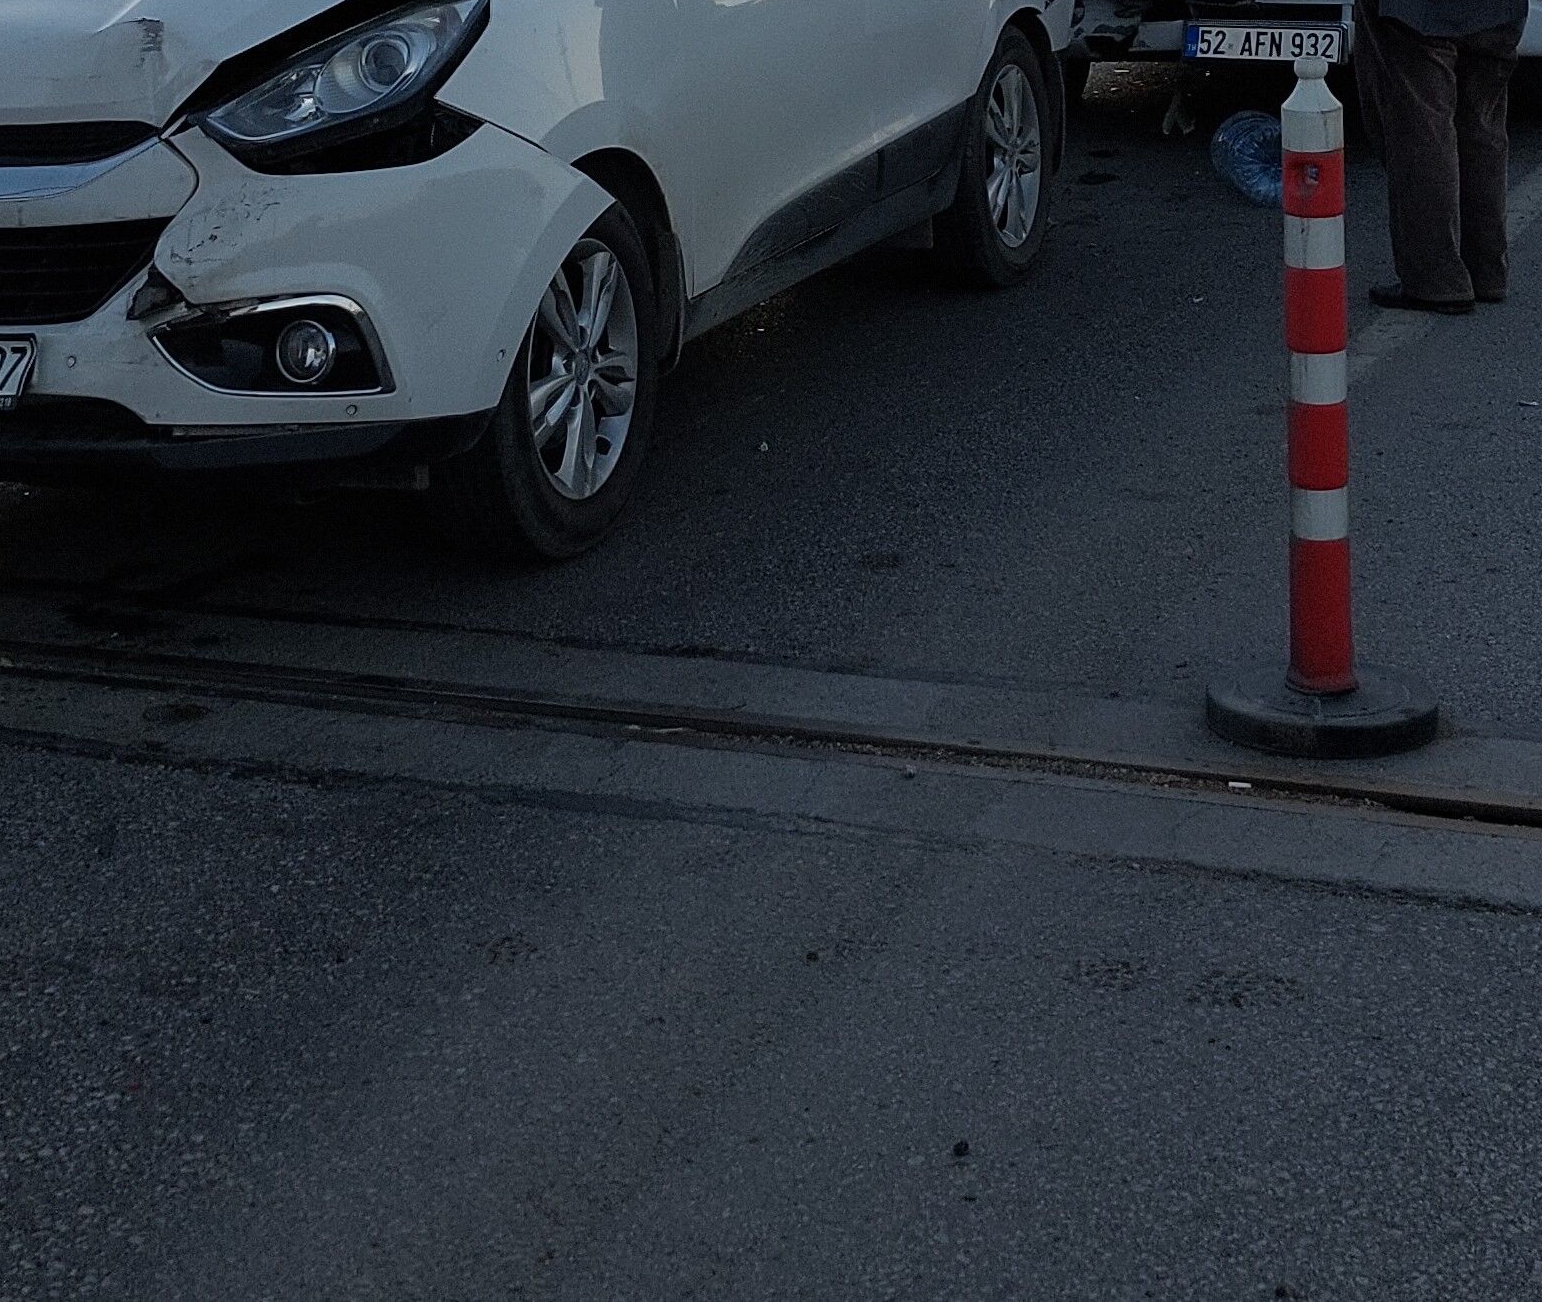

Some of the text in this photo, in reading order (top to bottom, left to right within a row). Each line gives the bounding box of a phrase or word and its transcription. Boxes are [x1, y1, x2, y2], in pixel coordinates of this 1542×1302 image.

[1199, 29, 1335, 59] 52 AFN 932
